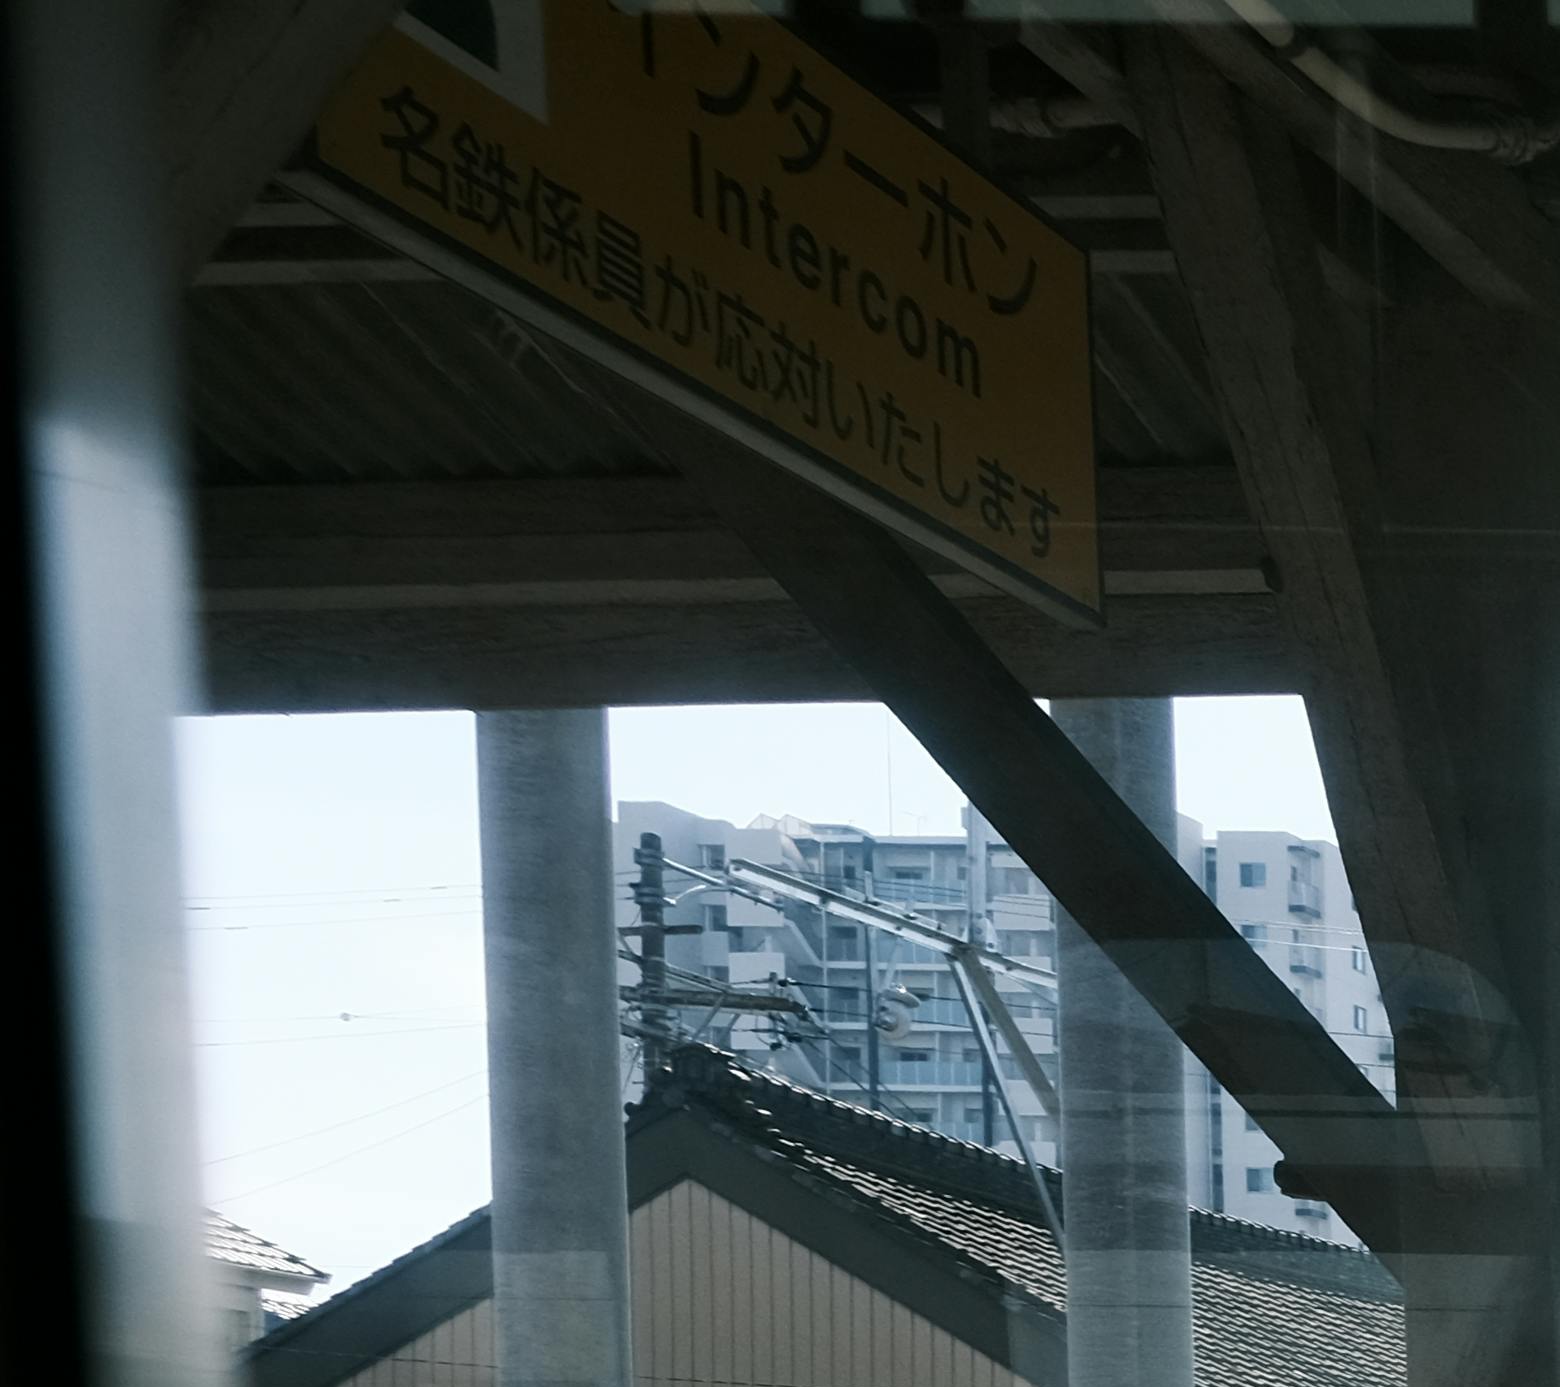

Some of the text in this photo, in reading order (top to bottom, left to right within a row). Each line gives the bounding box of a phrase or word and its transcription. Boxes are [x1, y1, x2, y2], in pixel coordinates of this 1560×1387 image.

[379, 84, 1061, 558] 名鉄係員が応対いたします
[688, 130, 982, 399] Intercom
